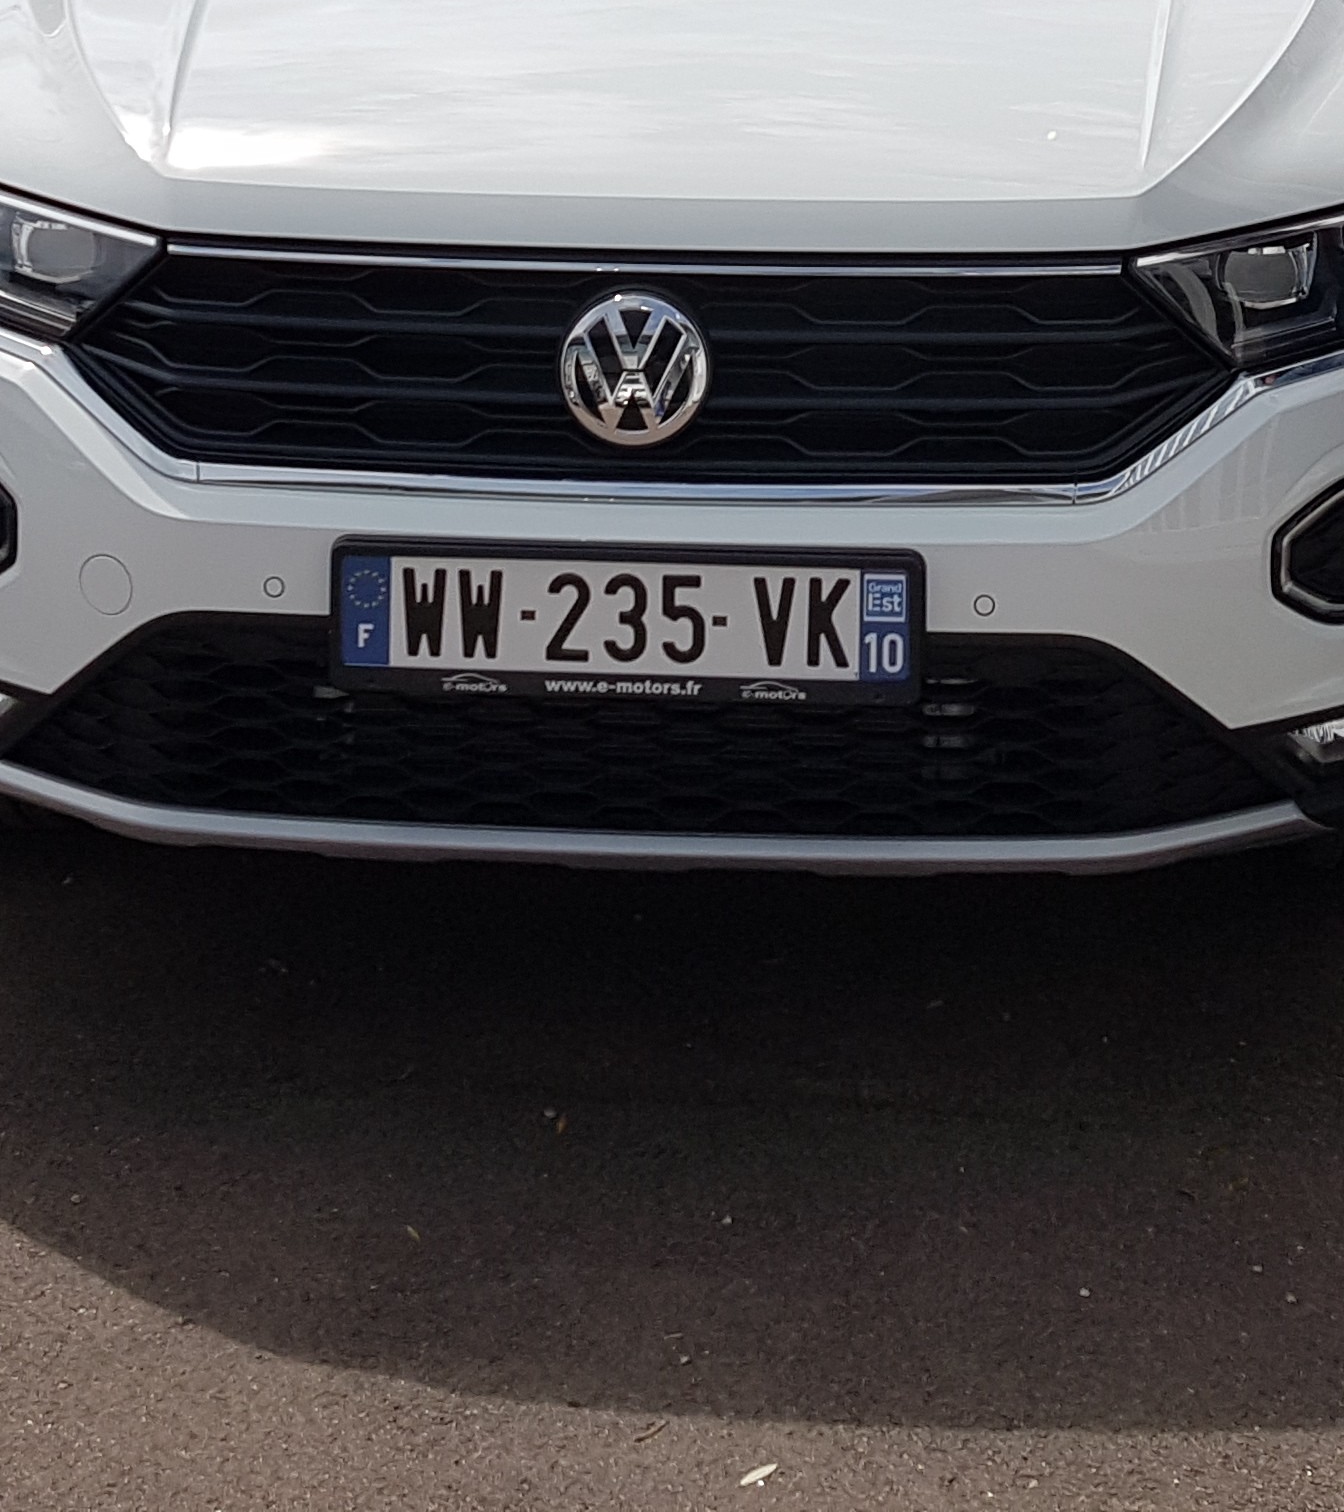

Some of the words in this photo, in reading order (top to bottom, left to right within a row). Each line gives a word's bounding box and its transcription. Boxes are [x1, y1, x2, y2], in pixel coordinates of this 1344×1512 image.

[868, 582, 903, 593] Grand
[868, 593, 902, 612] Est
[357, 623, 374, 648] F
[864, 632, 904, 673] 10
[544, 679, 703, 696] www.e-motors.fr
